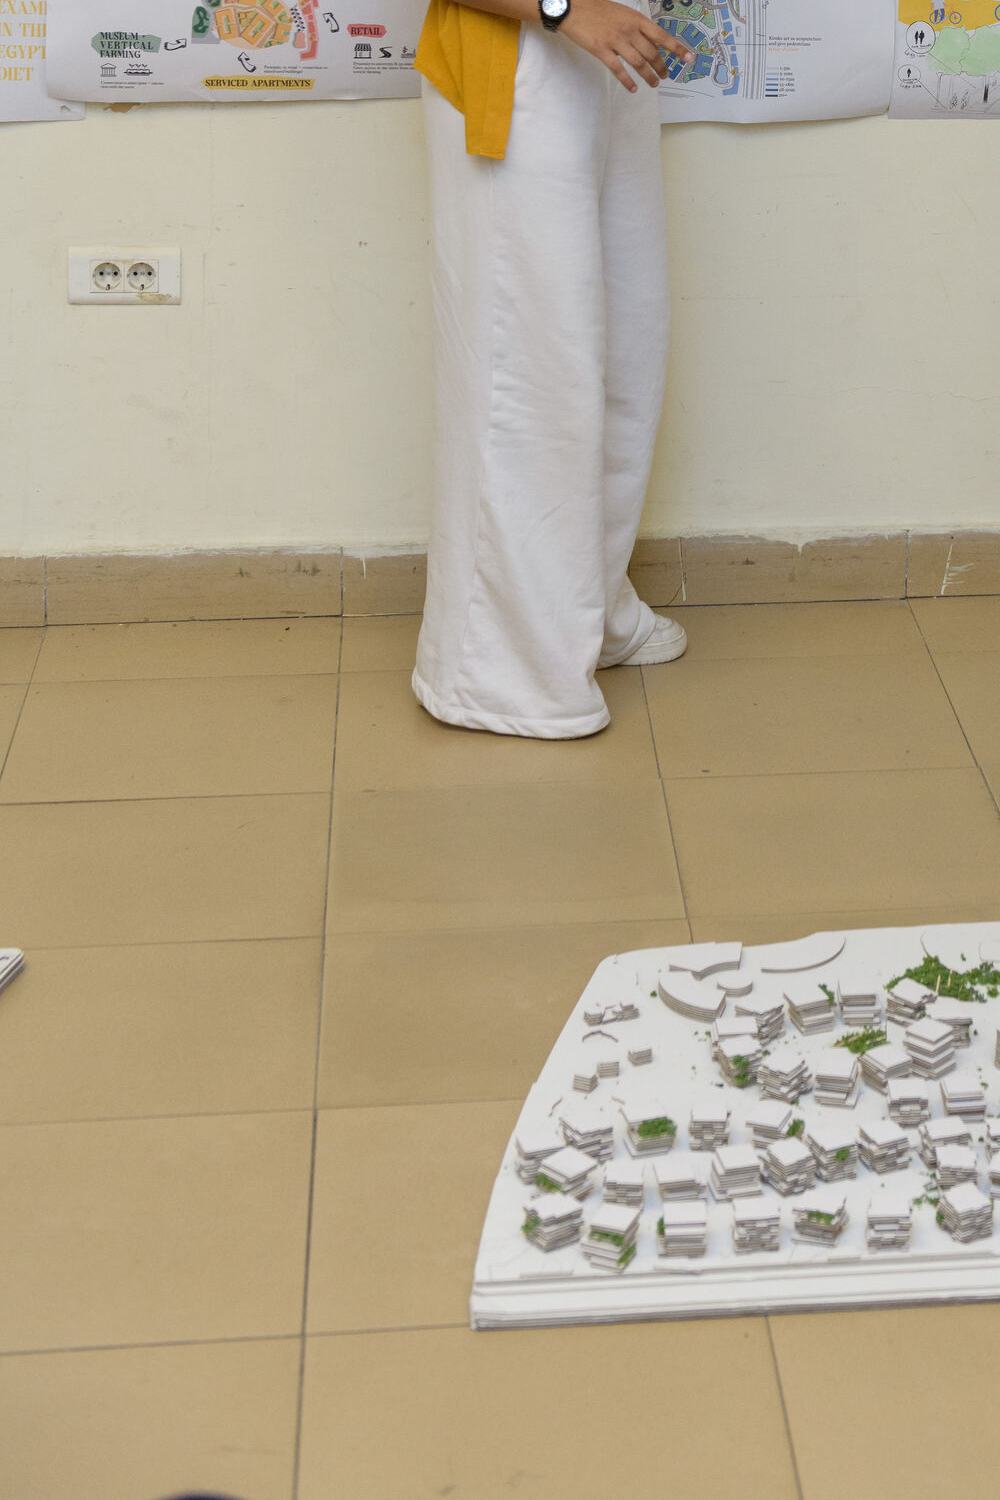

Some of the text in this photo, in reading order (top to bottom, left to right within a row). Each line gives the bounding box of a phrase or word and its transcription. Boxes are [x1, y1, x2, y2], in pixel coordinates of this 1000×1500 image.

[100, 31, 138, 40] MUSEUM
[350, 27, 383, 36] RETAIL
[100, 40, 153, 50] VERTICAL
[100, 50, 141, 59] FARMING
[205, 79, 310, 88] SERVICED APARTMENTS
